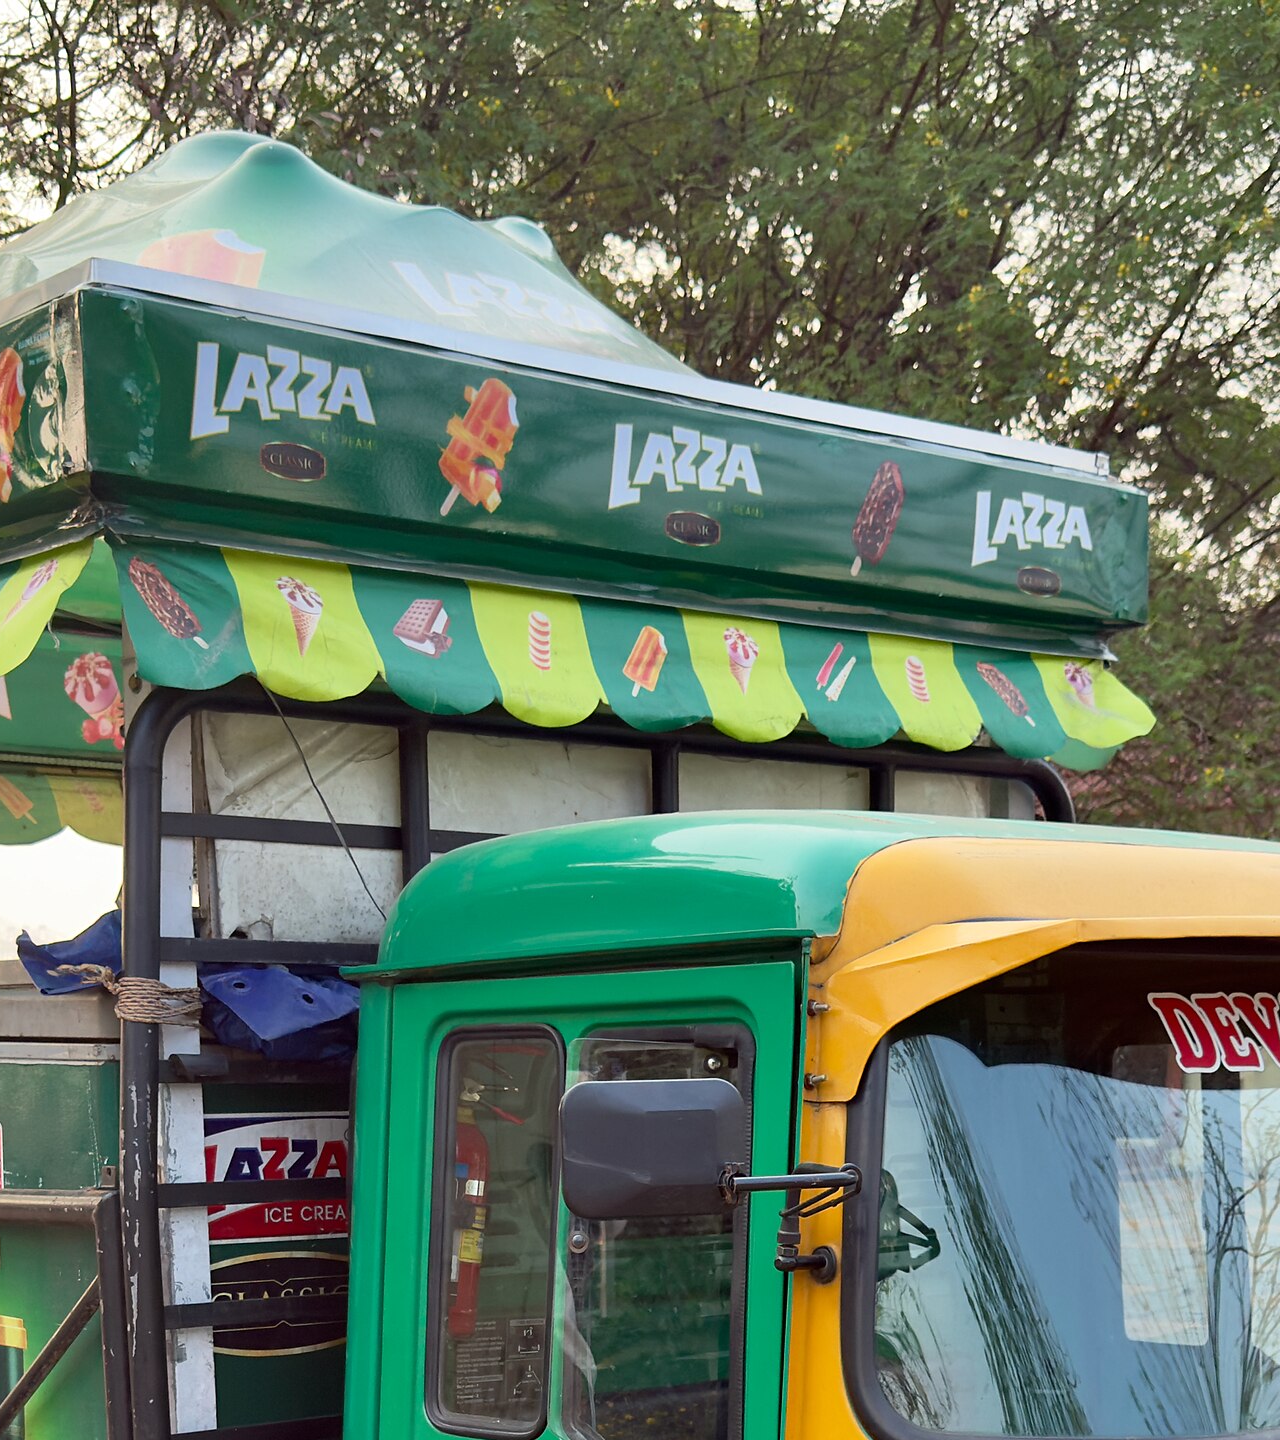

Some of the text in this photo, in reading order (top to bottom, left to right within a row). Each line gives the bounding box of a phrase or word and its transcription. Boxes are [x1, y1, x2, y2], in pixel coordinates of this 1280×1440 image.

[190, 341, 376, 440] LAZZA
[607, 423, 763, 510] LAZZA
[971, 490, 1093, 567] LAZZA
[264, 1207, 293, 1224] ICE
